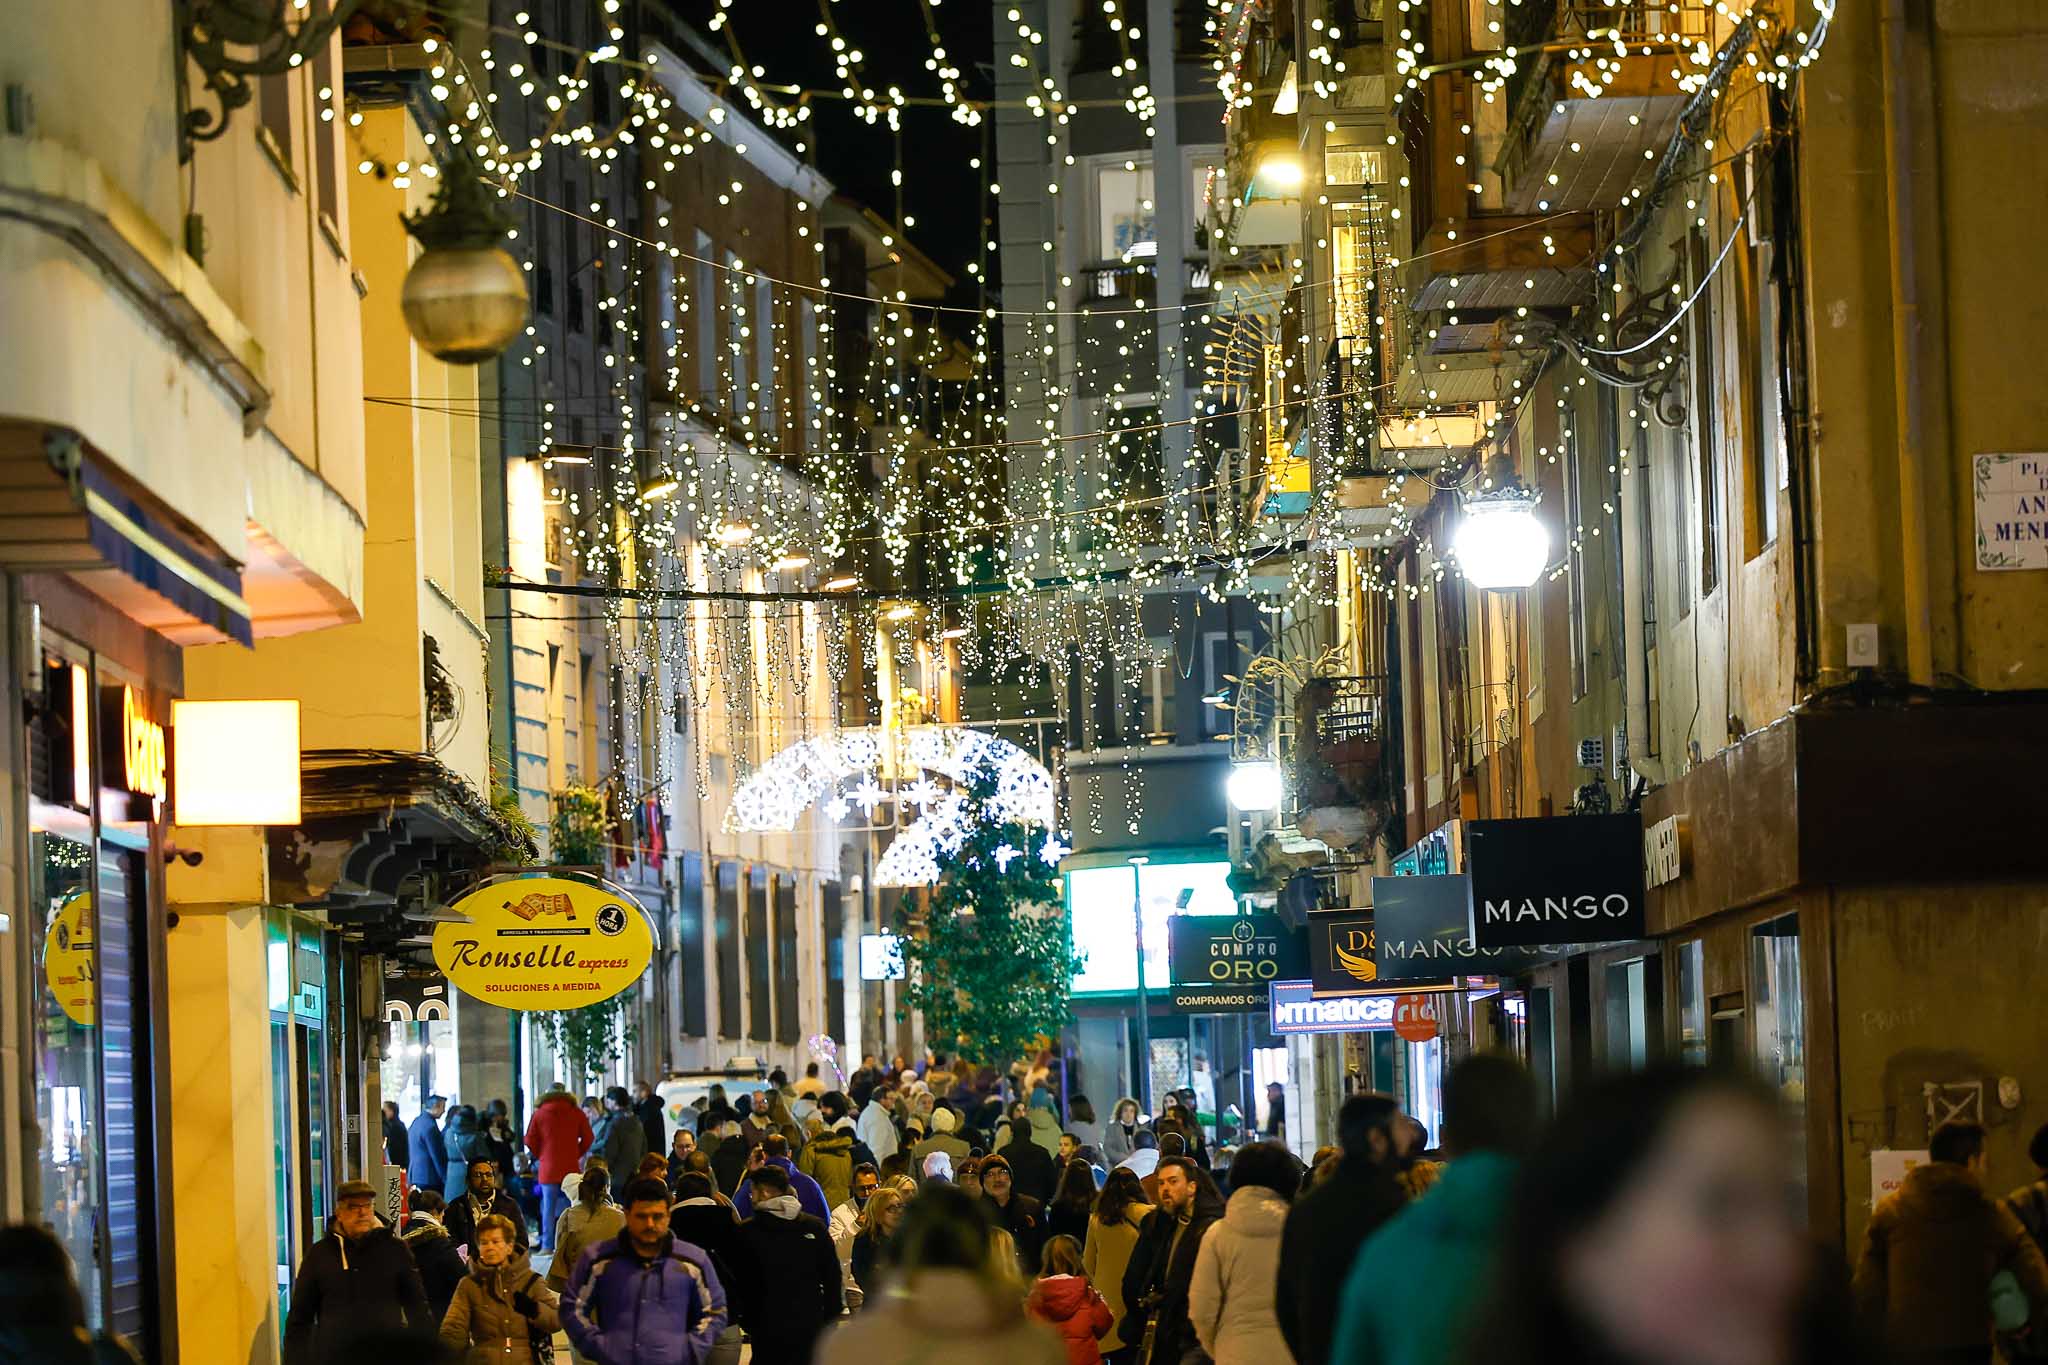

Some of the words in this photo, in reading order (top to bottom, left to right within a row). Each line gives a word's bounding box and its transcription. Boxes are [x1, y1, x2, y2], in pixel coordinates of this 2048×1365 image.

[2022, 462, 2048, 474] PL
[1485, 893, 1629, 924] MANGO
[600, 918, 618, 931] HORA
[1210, 943, 1277, 956] COMPRO
[450, 940, 576, 971] Rouselle
[578, 958, 628, 974] express
[1209, 960, 1278, 980] ORO
[485, 983, 550, 992] SOLUCIONES
[552, 983, 560, 992] A
[562, 982, 601, 991] MEDIDA
[1176, 995, 1244, 1006] COMPRAMOS
